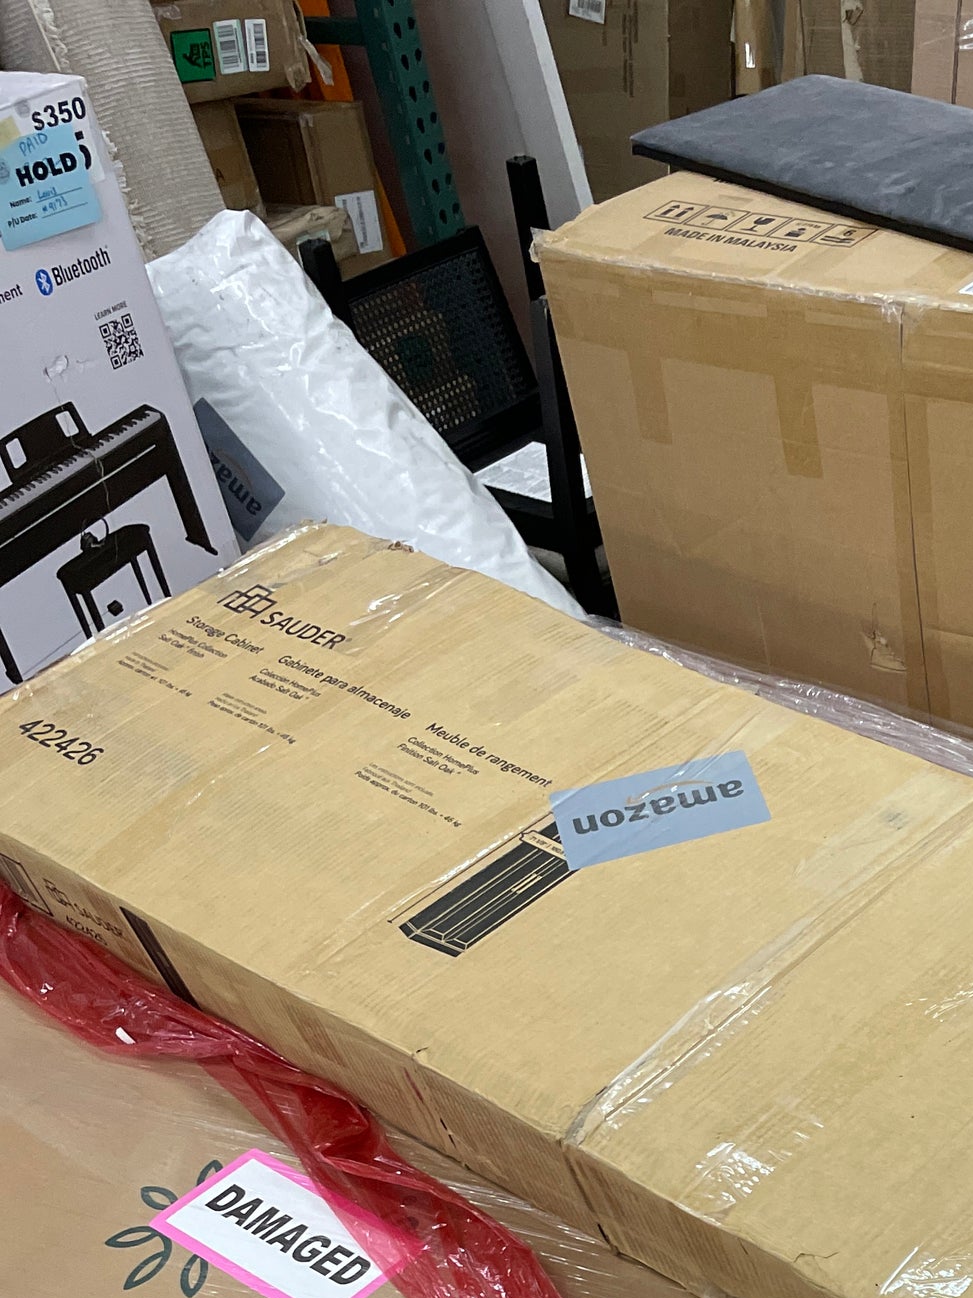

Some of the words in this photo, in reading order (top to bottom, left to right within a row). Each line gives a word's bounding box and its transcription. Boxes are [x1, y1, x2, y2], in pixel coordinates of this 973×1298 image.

[19, 132, 48, 157] PAID
[15, 152, 77, 188] HOLD
[664, 226, 709, 242] MADE
[708, 233, 726, 244] IN
[723, 234, 798, 253] MALAYSIA
[52, 247, 111, 286] Bluetooth
[94, 307, 112, 321] LEARN
[111, 301, 128, 315] MORE
[209, 450, 262, 516] amaz
[186, 615, 226, 639] Storage
[224, 633, 264, 656] Cabinet
[278, 655, 324, 680] Gabinete
[320, 675, 349, 693] para
[347, 685, 411, 720] almacenaje
[18, 719, 105, 766] 422426
[397, 743, 424, 760] Finition
[422, 756, 440, 768] Salt
[407, 736, 444, 758] Collection
[442, 754, 480, 775] HomePlus
[425, 722, 470, 749] Meuble
[469, 745, 487, 758] de
[485, 753, 553, 788] rangement
[572, 780, 744, 835] amazon
[204, 1183, 371, 1285] DAMAGED
